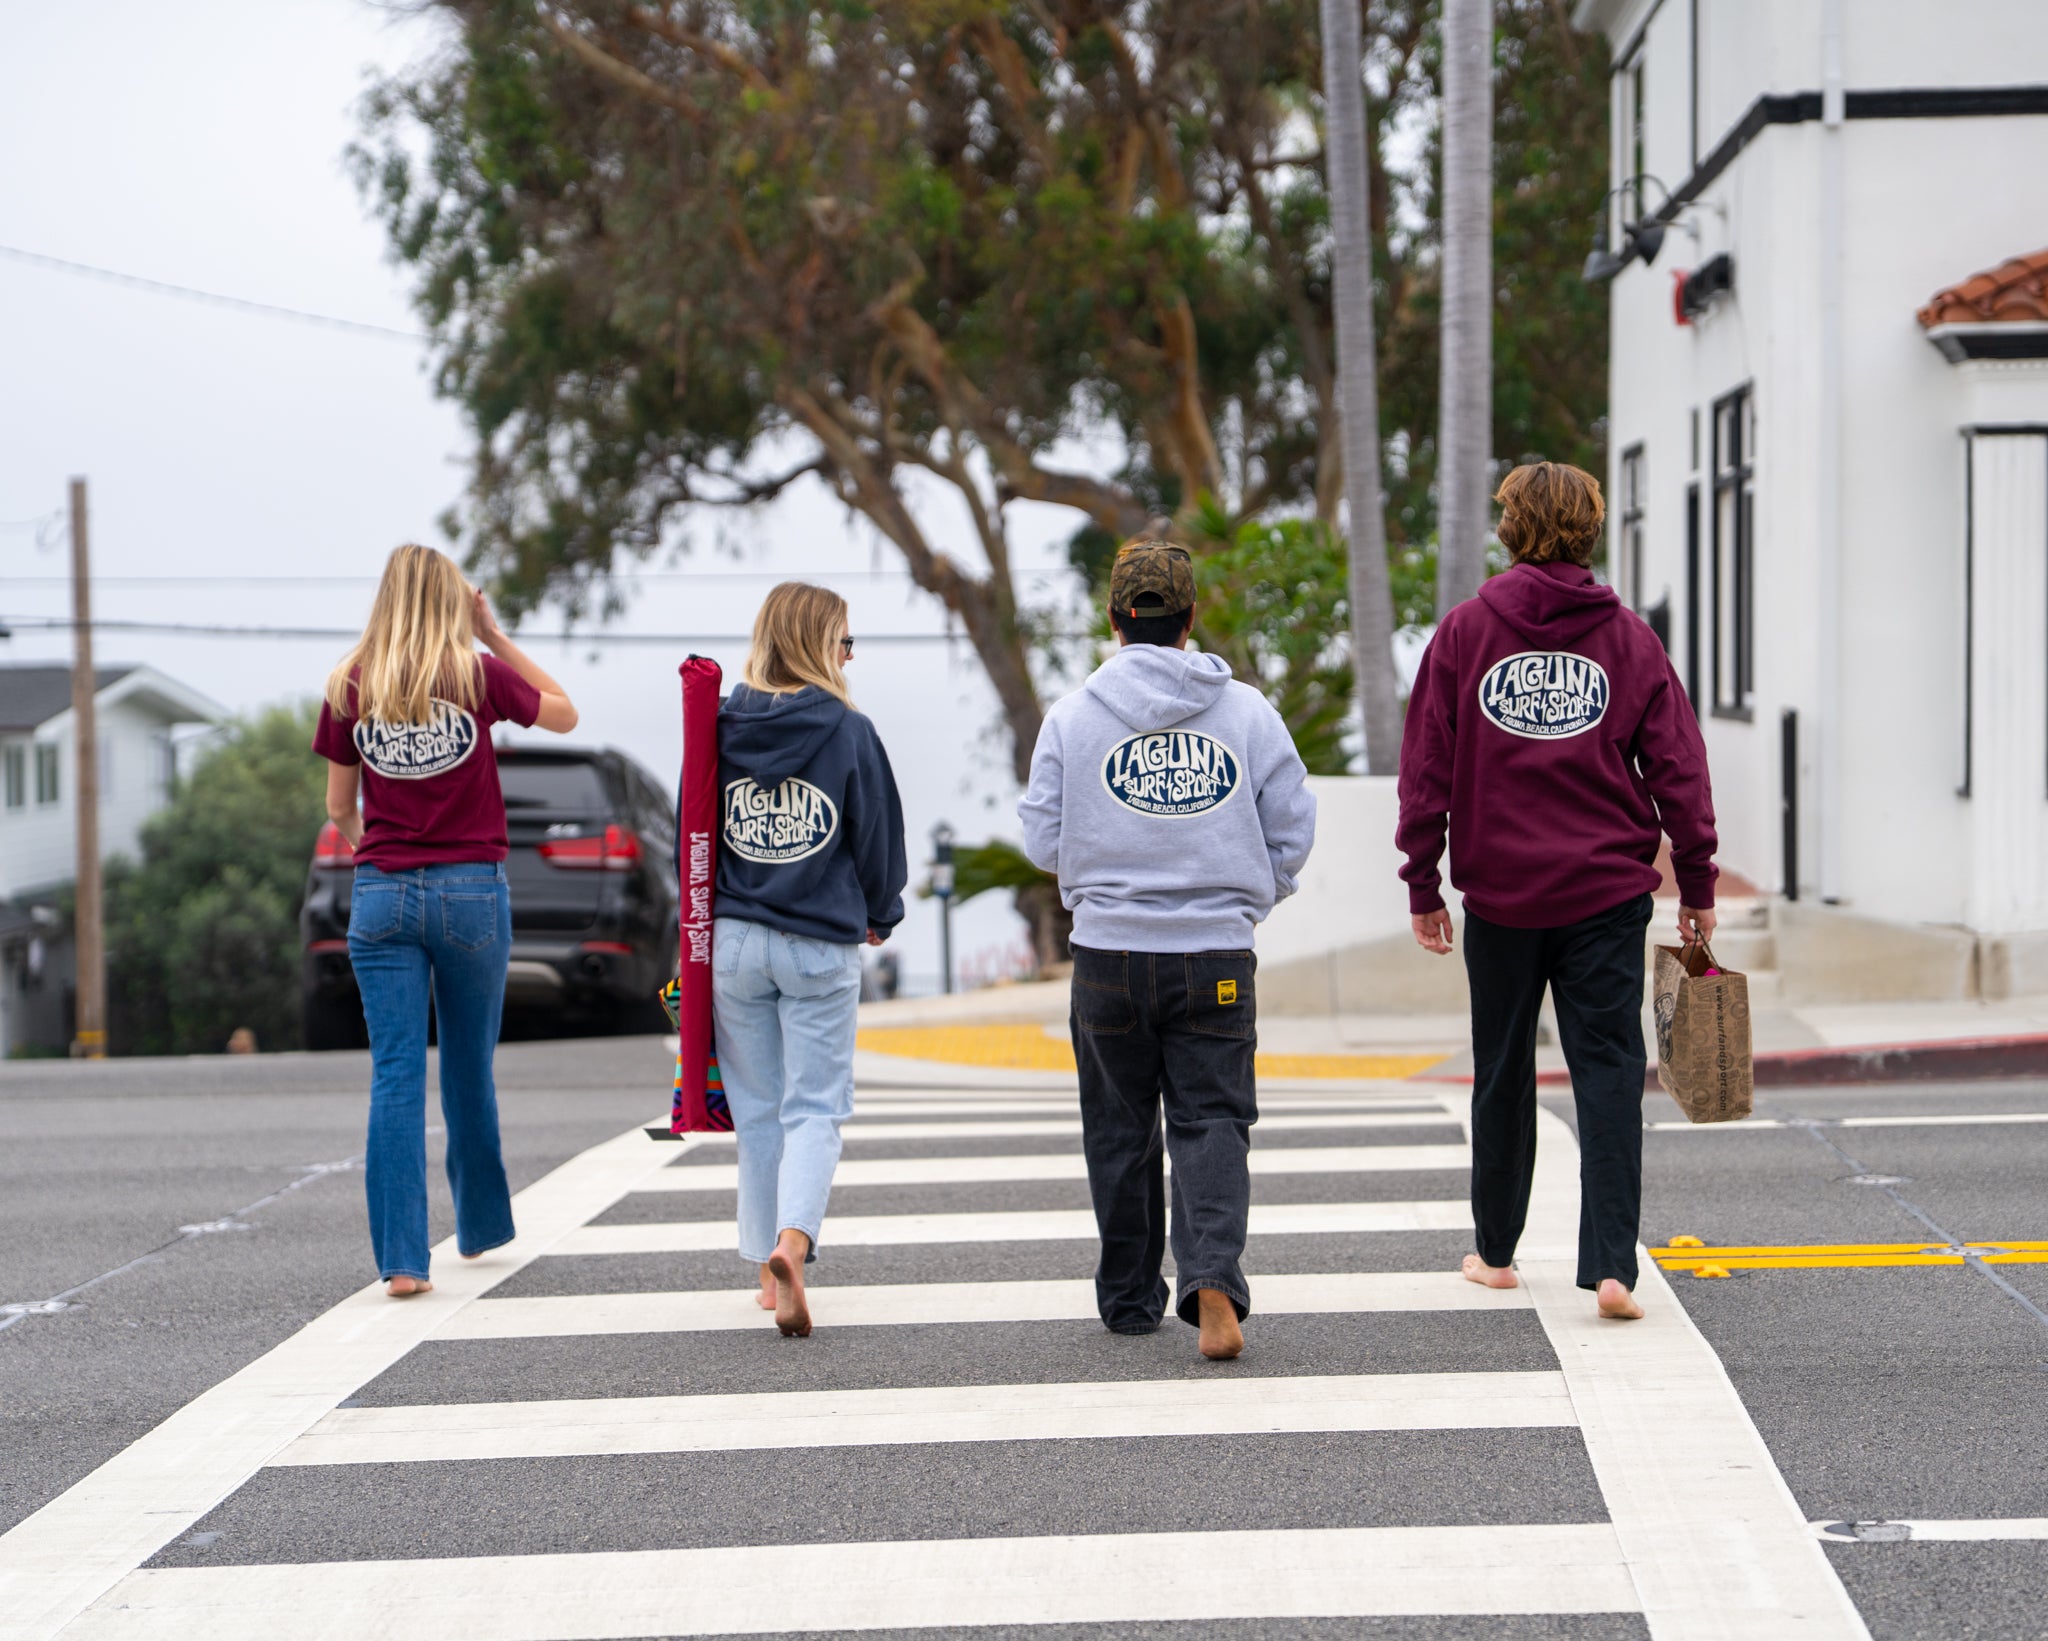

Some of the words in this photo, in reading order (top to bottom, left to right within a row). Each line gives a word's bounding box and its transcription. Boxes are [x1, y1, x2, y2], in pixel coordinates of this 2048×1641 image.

[1487, 656, 1602, 708] LAGUNA
[1499, 692, 1541, 723] SURF
[1546, 691, 1594, 723] SPORT
[1551, 717, 1587, 734] CALIFORNIA
[374, 736, 410, 765] SURF
[416, 732, 460, 763] SPORT
[1112, 733, 1231, 787] LAGUNA
[1124, 771, 1165, 802] SURF
[1172, 768, 1221, 802] SPORT
[1177, 797, 1215, 813] CALIFORNIA
[730, 816, 767, 847] SURF
[773, 815, 817, 847] SPORT
[689, 831, 709, 885] LAGUNA
[689, 886, 710, 919] SURF
[687, 929, 711, 965] SPORT
